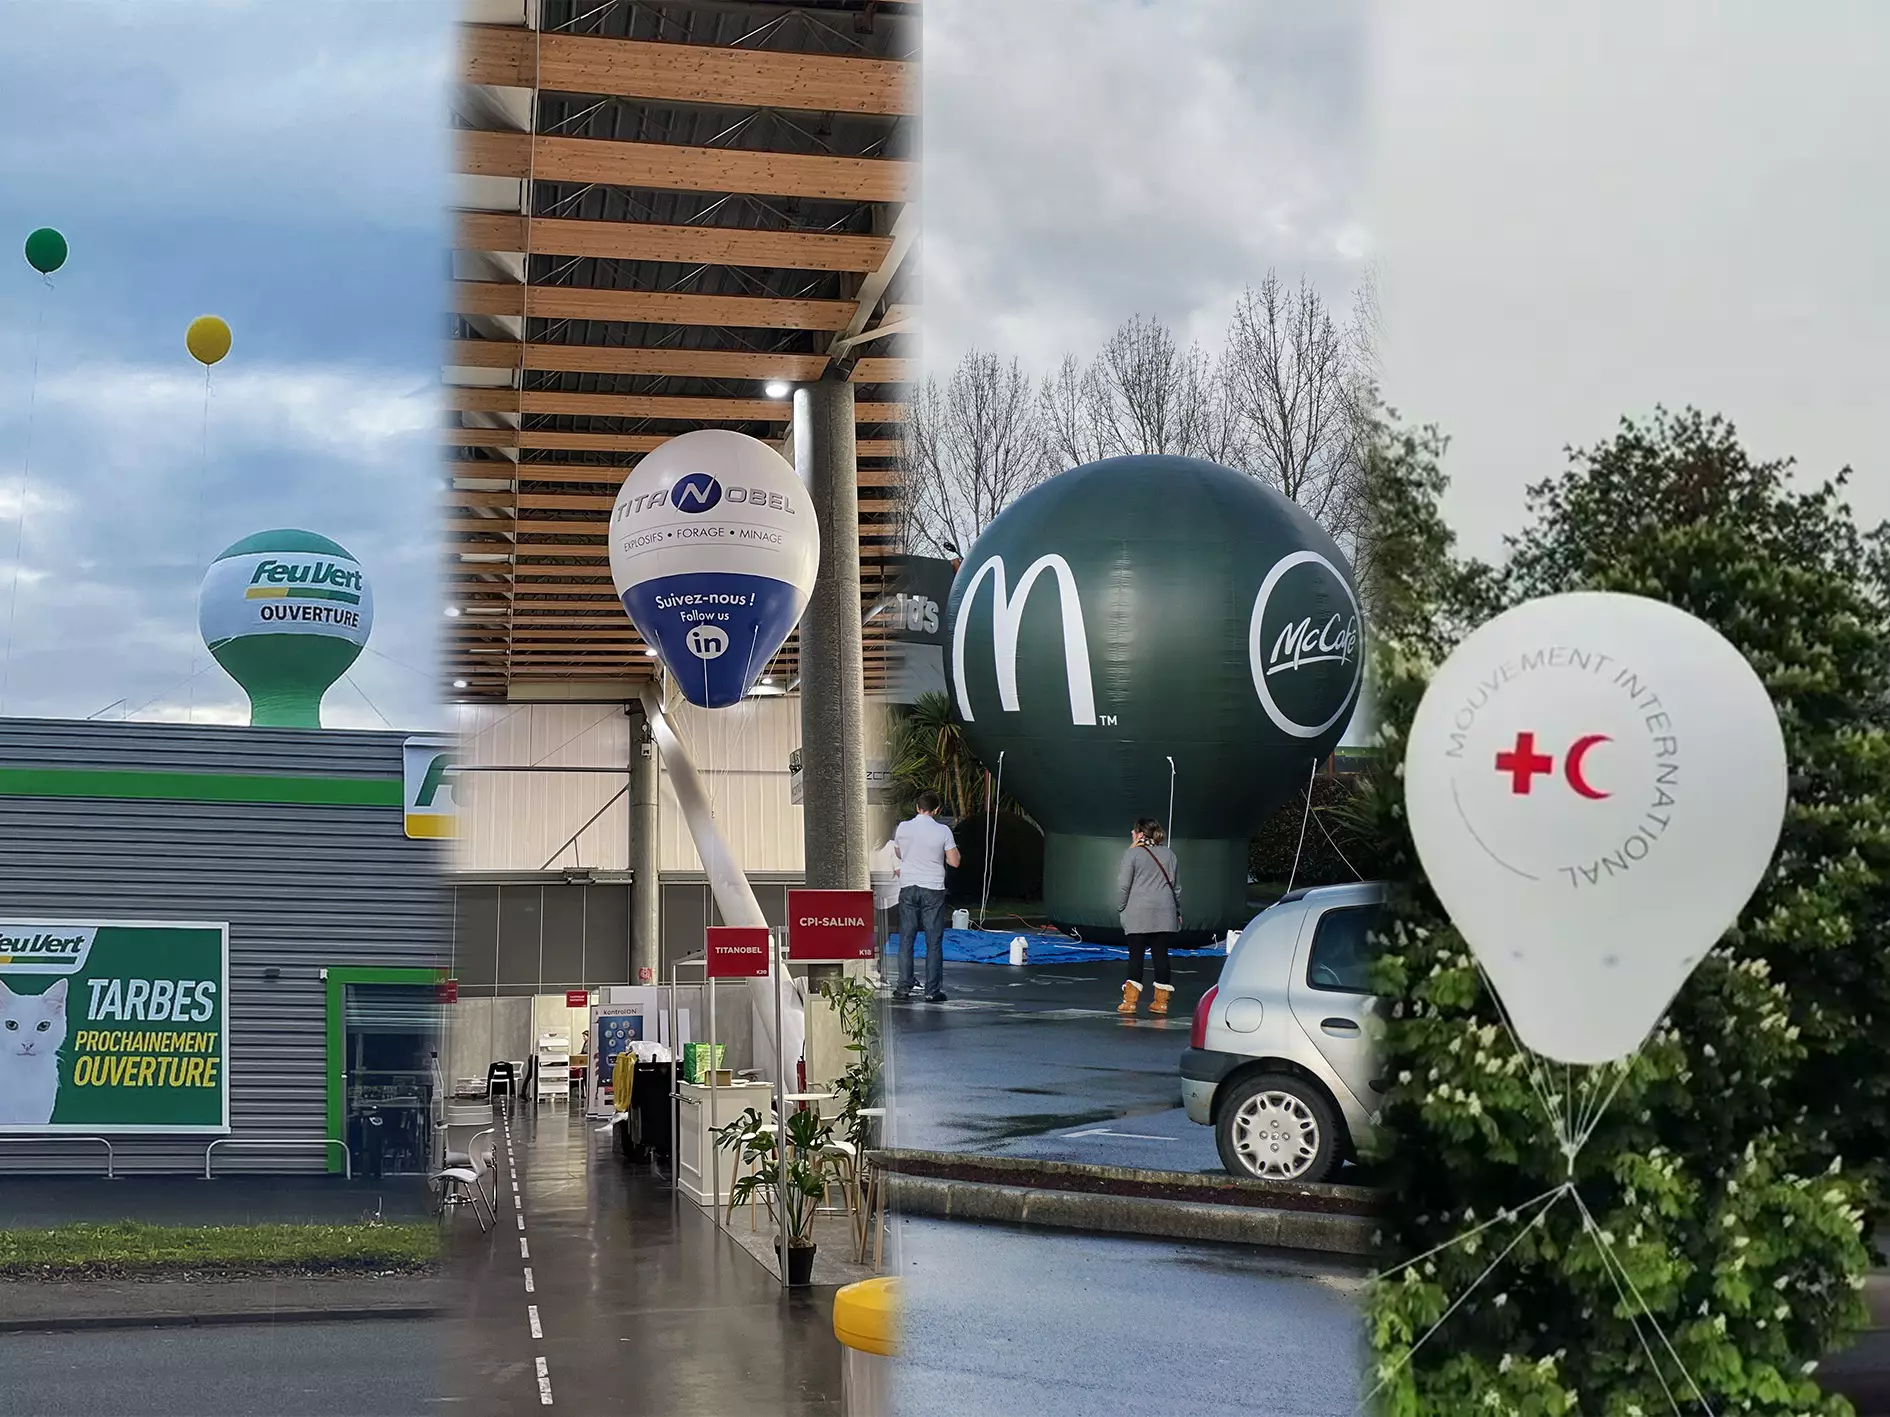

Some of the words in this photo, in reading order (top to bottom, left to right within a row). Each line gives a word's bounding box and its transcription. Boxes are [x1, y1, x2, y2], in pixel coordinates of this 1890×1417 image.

[616, 473, 795, 522] TITANOBEL
[624, 532, 664, 552] EXPLOSIFS
[677, 527, 725, 539] FORAGE
[739, 530, 783, 545] MINAGE
[260, 605, 360, 628] OUVERTURE
[680, 609, 715, 622] Follow
[717, 612, 730, 621] us
[692, 631, 722, 653] in
[1099, 715, 1118, 726] TM
[1445, 646, 1615, 759] MOUVEMENT
[1557, 667, 1680, 889] INTERNATIONAL
[799, 917, 865, 927] CPI-SALINA
[715, 946, 763, 954] TITANOBEL
[87, 978, 217, 1022] TARBES
[75, 1031, 218, 1053] PROCHAINEMENT
[74, 1056, 220, 1087] OUVERTURE
